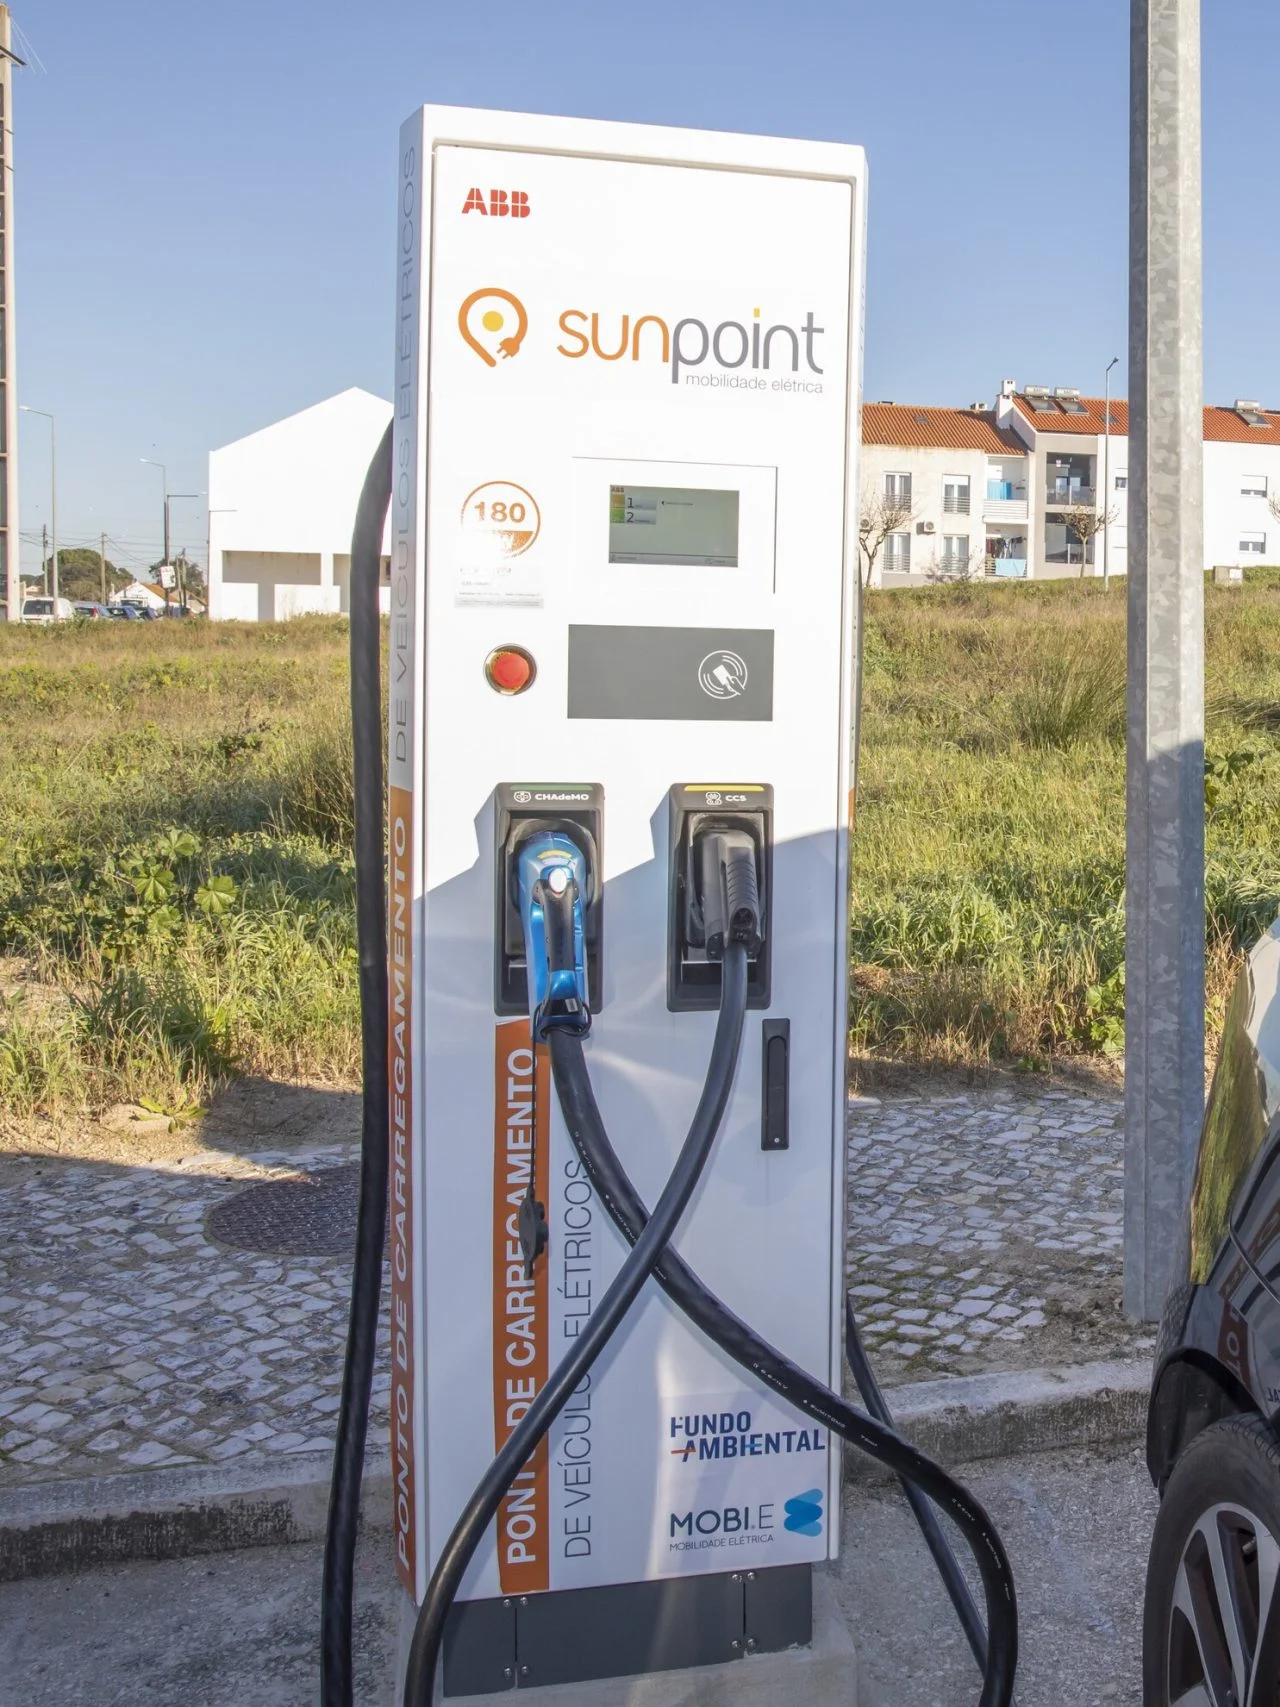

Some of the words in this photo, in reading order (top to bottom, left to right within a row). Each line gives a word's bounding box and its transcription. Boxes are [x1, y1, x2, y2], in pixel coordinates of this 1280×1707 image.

[461, 187, 531, 218] ABB
[556, 307, 825, 384] sunpoint
[685, 373, 767, 390] mobilidade
[771, 378, 824, 394] elétrica
[474, 501, 526, 523] 180
[395, 697, 407, 764] DE
[534, 793, 590, 801] CHAdeMO
[724, 794, 747, 802] CCS
[393, 815, 407, 1283] CARREGAMENTO
[395, 1296, 408, 1362] DE
[557, 1372, 592, 1509] VEÍCUL
[670, 1411, 752, 1438] FUNDO
[671, 1429, 826, 1463] AMBIENTAL
[396, 1383, 409, 1572] PONTO
[506, 1448, 537, 1565] PON
[564, 1515, 592, 1559] DE
[669, 1536, 727, 1552] MOBILIDADE
[728, 1533, 774, 1547] ELÉTRICA
